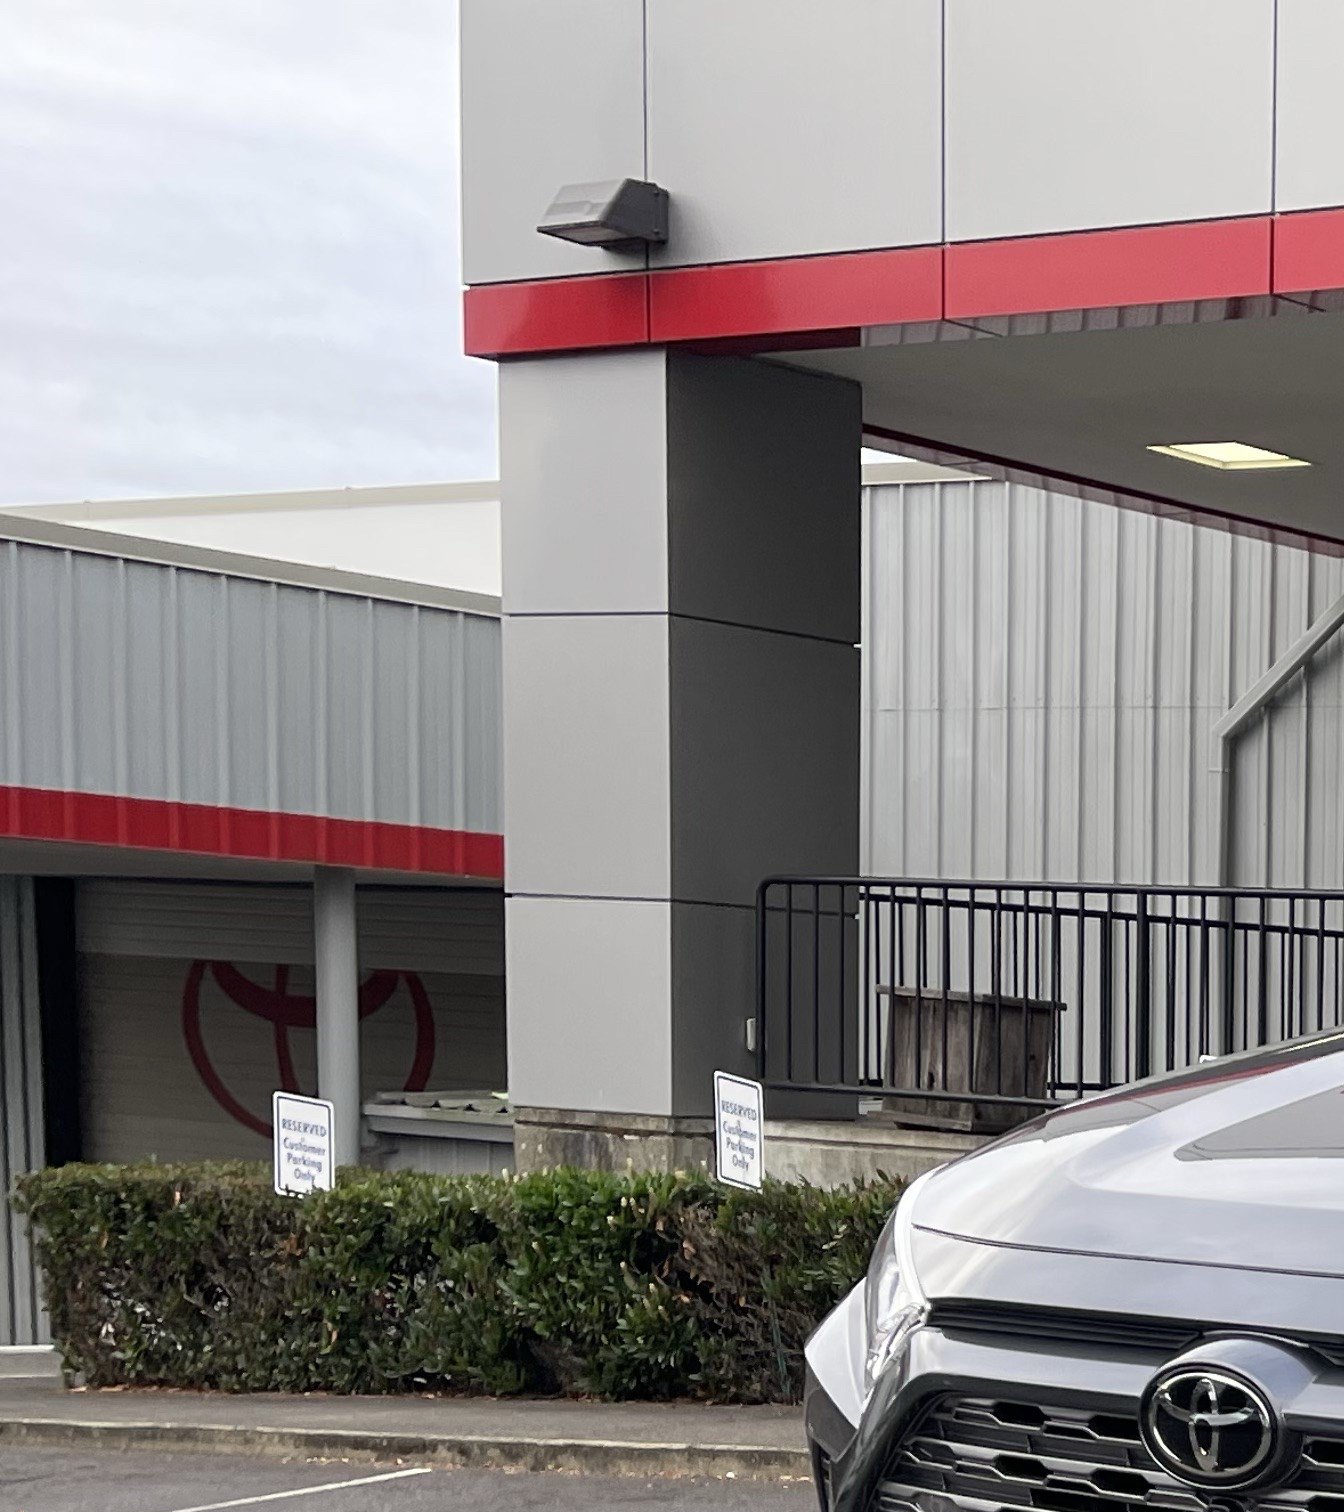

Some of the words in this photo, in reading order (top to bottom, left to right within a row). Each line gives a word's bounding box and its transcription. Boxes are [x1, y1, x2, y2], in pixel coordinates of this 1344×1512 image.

[721, 1100, 756, 1121] RESERVED
[282, 1118, 326, 1137] RESERVED
[283, 1137, 325, 1156] Customer
[287, 1152, 322, 1172] Parking
